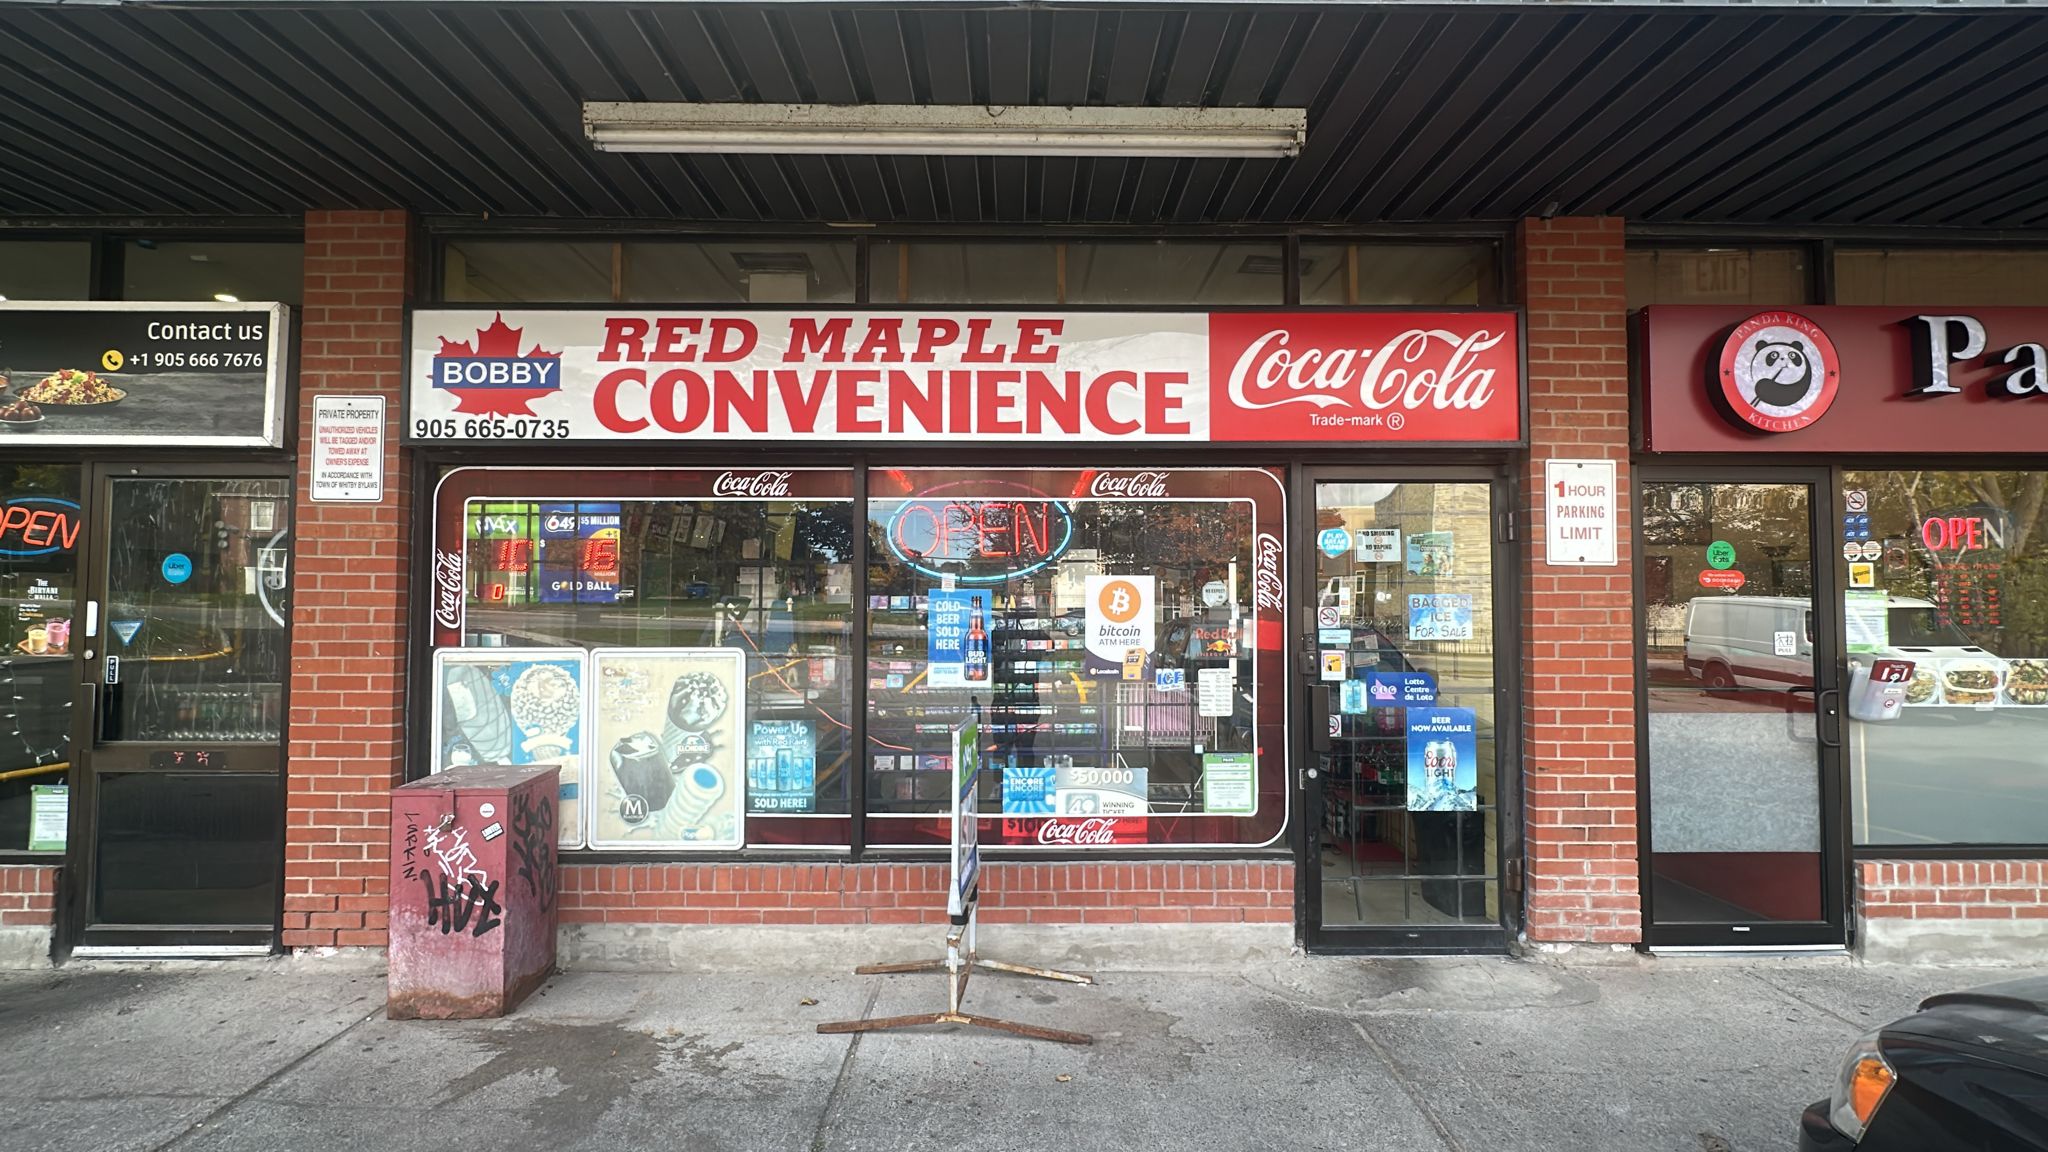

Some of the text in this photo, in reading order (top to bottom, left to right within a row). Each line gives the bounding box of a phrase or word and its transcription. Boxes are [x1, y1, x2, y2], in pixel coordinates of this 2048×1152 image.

[147, 322, 263, 341] Contact us
[1736, 314, 1819, 339] PANDA KING
[597, 318, 1065, 363] RED MAPLE
[130, 353, 263, 367] +1 905 666 7676
[443, 362, 554, 384] BOBBY
[1228, 329, 1506, 409] Coca-Cola
[593, 368, 1191, 435] CONVENIENCE
[319, 410, 379, 419] PRIVATE PROPERTY
[1310, 414, 1383, 427] Trade-mark
[1748, 412, 1811, 430] KITCHEN
[319, 426, 355, 434] UNAUTHORIZED
[415, 419, 570, 438] 905 665-0735
[320, 437, 331, 445] WILL
[332, 437, 339, 445] BE
[328, 448, 368, 456] TOWED AWAY AT
[348, 458, 369, 466] EXPENSE
[328, 472, 359, 480] ACCORDANCE
[360, 472, 373, 480] WITH
[331, 481, 338, 489] OF
[339, 481, 357, 489] WHITBY
[358, 481, 378, 489] BYLAWS
[712, 471, 793, 496] Coca-Cola
[1091, 472, 1170, 497] Coca-Cola
[1554, 482, 1606, 497] 1 HOUR
[1556, 506, 1605, 519] PARKING
[590, 516, 620, 526] MILLION
[0, 507, 80, 549] PEN
[897, 503, 1048, 558] OPEN
[1559, 526, 1602, 540] LIMIT
[1922, 517, 2004, 551] OPEN
[1257, 533, 1282, 613] Coca-Cola
[27, 586, 58, 594] BIRYANI
[435, 548, 462, 629] Coca-Cola
[586, 582, 612, 591] BALL
[935, 601, 960, 612] COLD
[1412, 598, 1469, 609] BAGGED
[936, 614, 960, 625] BEER
[1431, 612, 1451, 622] ICE
[936, 627, 960, 637] SOLD
[1099, 625, 1141, 637] bitcoin
[1195, 628, 1243, 640] Red Bull
[936, 639, 960, 650] HERE
[1099, 638, 1141, 646] ATM HERE
[1156, 670, 1184, 686] ICE
[1371, 685, 1397, 695] OLG
[753, 723, 808, 737] Power Up
[677, 744, 710, 753] KLONDIKE
[1071, 770, 1134, 785] $50,000
[1426, 769, 1455, 777] LIGHT
[1010, 784, 1044, 792] ENCORE
[625, 800, 643, 815] M
[754, 798, 807, 808] SOLD HERE!
[1037, 818, 1118, 844] Coca-Cola
